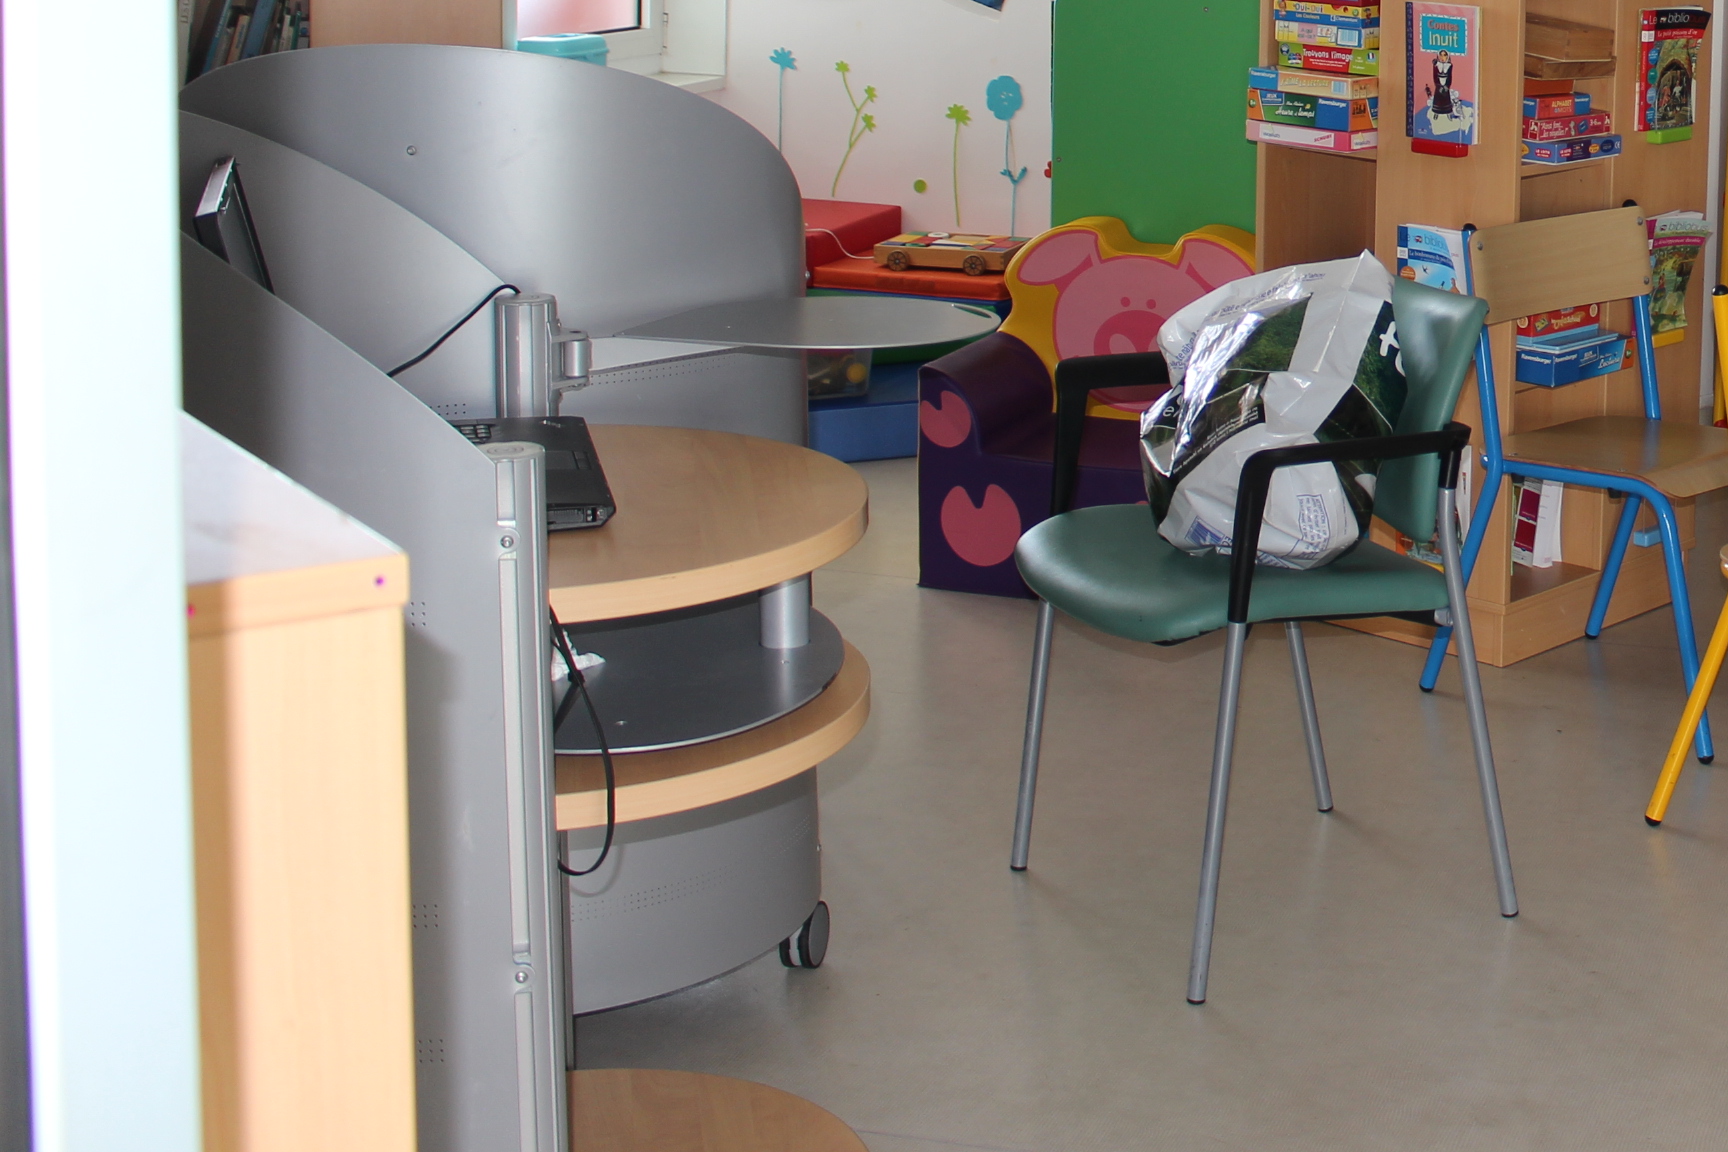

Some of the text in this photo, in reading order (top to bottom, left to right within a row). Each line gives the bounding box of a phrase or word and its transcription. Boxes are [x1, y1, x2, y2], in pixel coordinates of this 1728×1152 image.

[1295, 3, 1323, 13] Oui-Oui
[1427, 19, 1459, 32] Contes
[1648, 15, 1658, 25] Le
[1429, 30, 1458, 48] Inuit
[1302, 48, 1329, 59] Trouvons
[1331, 50, 1353, 63] l'image
[1551, 99, 1573, 108] ALPHABET
[1521, 353, 1552, 364] Ravensburger
